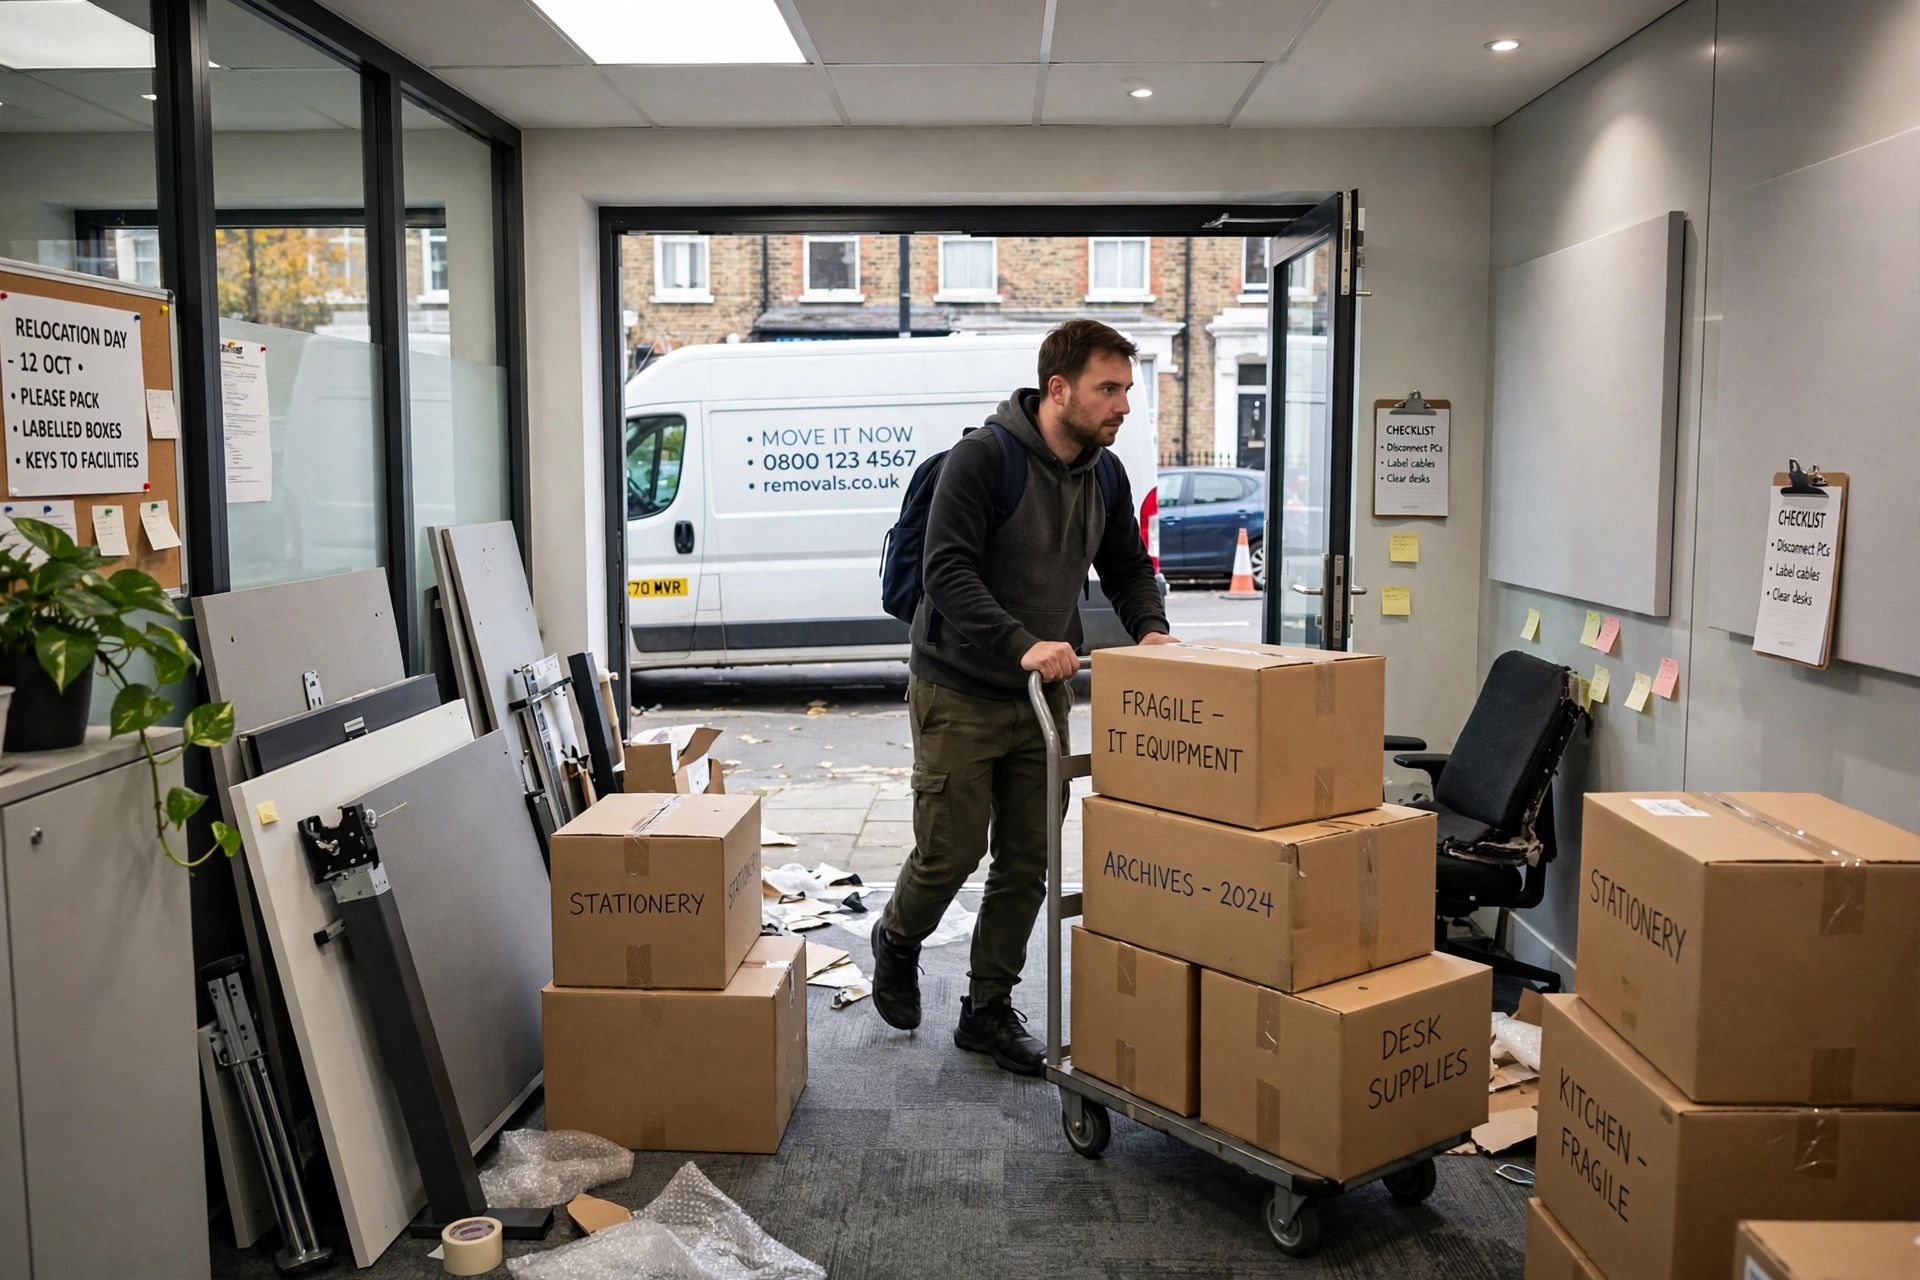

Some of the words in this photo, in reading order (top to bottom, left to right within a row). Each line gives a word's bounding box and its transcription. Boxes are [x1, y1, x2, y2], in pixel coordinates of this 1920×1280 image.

[15, 317, 100, 346] RELOCATION
[104, 329, 127, 349] DAY
[20, 352, 38, 372] 12
[43, 354, 72, 375] OCT
[21, 387, 66, 407] PLEASE
[70, 391, 100, 409] PACK
[22, 419, 82, 438] LABELLED
[86, 422, 122, 439] BOXES
[762, 428, 826, 447] MOVE
[834, 427, 851, 444] IT
[859, 426, 913, 444] NOW
[1386, 425, 1436, 436] CHECKLIST
[1387, 443, 1428, 453] Disconnect
[1430, 443, 1443, 453] PCs
[25, 451, 58, 469] KEYS
[60, 451, 78, 469] TO
[81, 451, 139, 468] FACILITIES
[763, 452, 820, 471] 0800
[825, 451, 860, 469] 123
[866, 449, 917, 467] 4567
[1387, 458, 1409, 468] Label
[1410, 458, 1436, 468] cables
[764, 473, 900, 493] removals.co.uk
[1386, 473, 1407, 483] Clear
[1409, 474, 1431, 484] desks
[1778, 509, 1827, 529] CHECKLIST
[1777, 539, 1815, 556] Disconnect
[1816, 542, 1831, 557] PCs
[1775, 564, 1795, 578] Label
[1796, 566, 1820, 582] cables
[628, 581, 650, 595] 70
[1772, 587, 1791, 601] Clear
[1793, 589, 1813, 606] desks
[1122, 689, 1204, 724] FRAGILE
[1107, 728, 1127, 753] IT
[1135, 733, 1244, 774] EQUIPMENT
[1103, 850, 1195, 897] ARCHIVES
[1220, 881, 1274, 918] 2024
[570, 892, 705, 916] STATIONERY
[1590, 868, 1687, 964] STATIONERY
[1382, 1014, 1442, 1060] DESK
[1368, 1048, 1468, 1109] SUPPLIES
[1559, 1067, 1631, 1166] KITCHEN
[1561, 1127, 1629, 1223] FRAGILE
